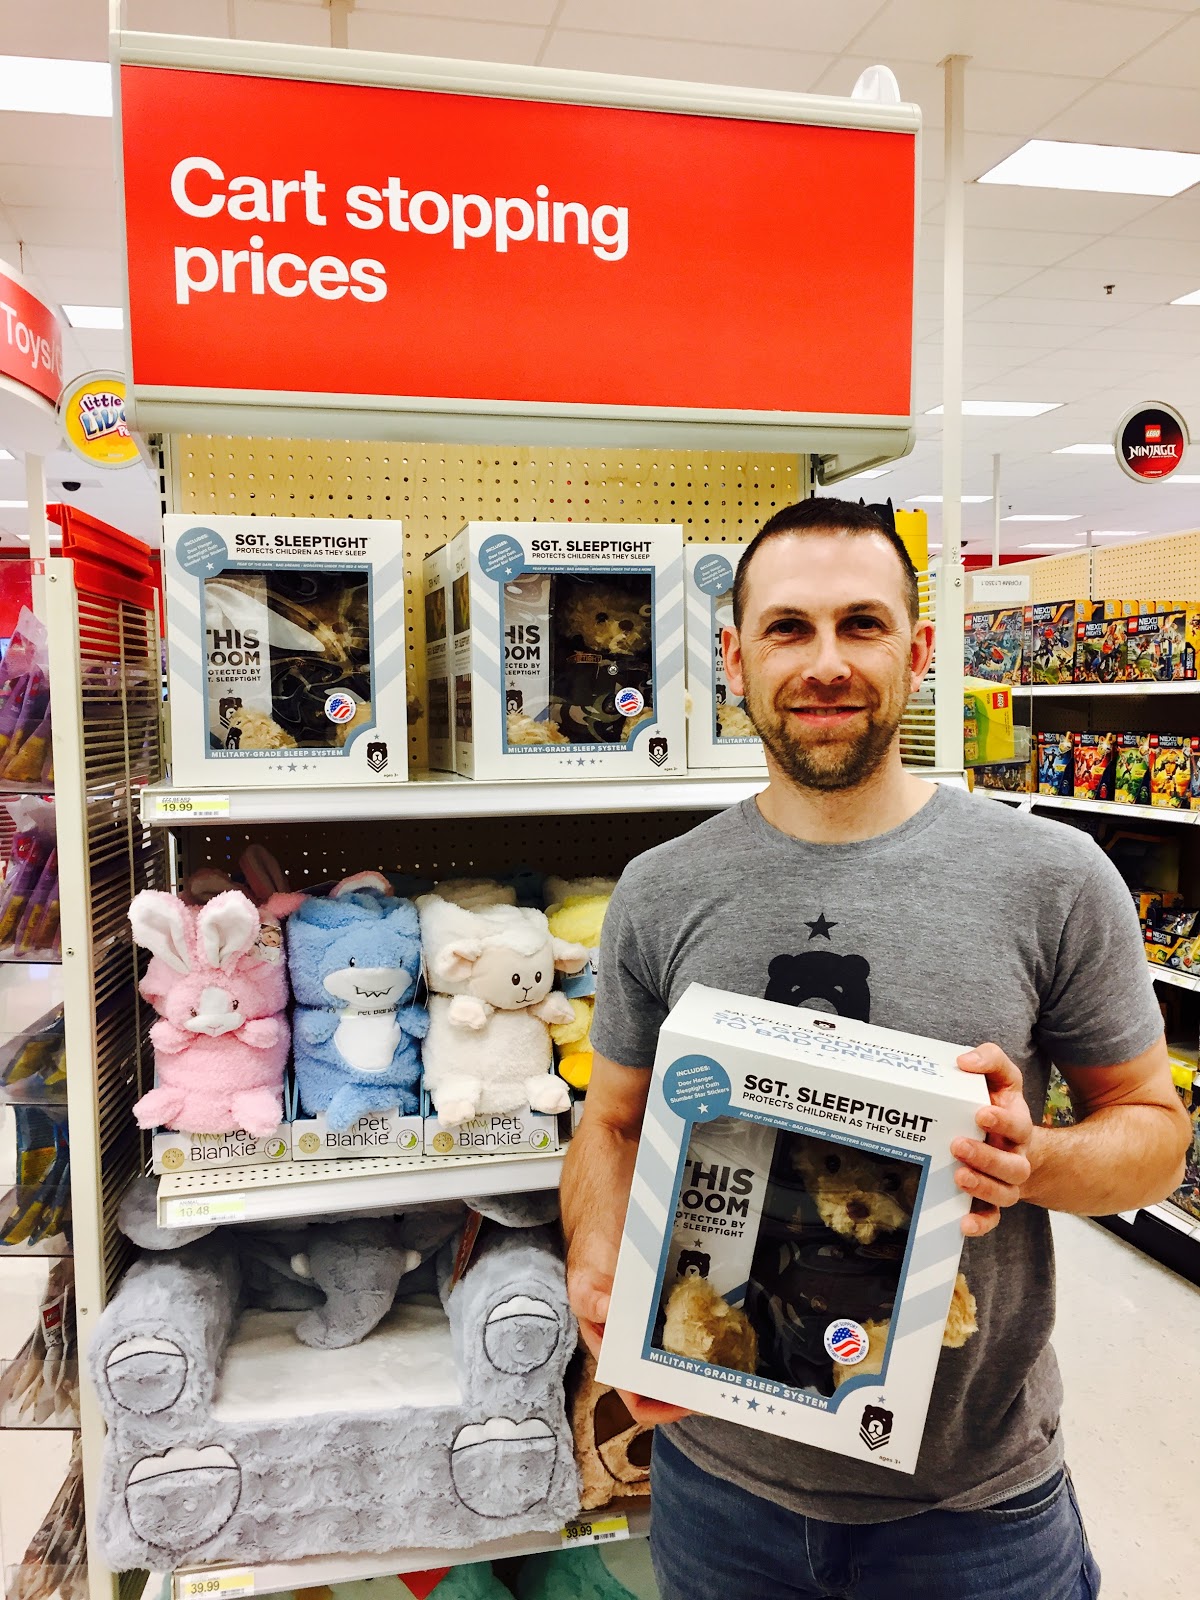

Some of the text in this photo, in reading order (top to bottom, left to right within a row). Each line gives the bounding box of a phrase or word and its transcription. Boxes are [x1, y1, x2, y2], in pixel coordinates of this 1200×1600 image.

[170, 156, 629, 261] Cart stopping
[174, 234, 388, 305] prices
[83, 394, 122, 411] Little
[1145, 429, 1161, 438] LEGO
[1128, 444, 1178, 460] NINJAGO
[235, 534, 269, 547] SGT.
[531, 540, 562, 551] SGT.
[1138, 617, 1158, 626] NEXO
[206, 629, 260, 649] HIS
[505, 625, 540, 644] HIS
[206, 651, 260, 666] OOM
[505, 646, 540, 660] OM
[211, 749, 344, 758] MILITARY-GRADE SLEEP SYSTEM
[508, 745, 571, 753] MILITARY-GRADE
[163, 803, 193, 811] 19.99
[712, 1012, 940, 1068] SAY GOODNIGHT
[713, 1017, 944, 1077] TO BAD DREAMS.
[676, 1065, 711, 1077] INCLUDES:
[692, 1075, 714, 1083] Hanger
[743, 1074, 790, 1099] SGT.
[670, 1095, 694, 1104] Slumber
[706, 1087, 730, 1096] Stickers
[676, 1081, 720, 1095] Sleeptight Oath
[358, 1117, 389, 1131] Pet
[491, 1116, 520, 1130] Pet
[742, 1091, 927, 1143] PROTECTS CHILDREN AS THEY SLEEP
[326, 1132, 389, 1147] Blankie
[459, 1131, 521, 1146] Blankie
[773, 1119, 788, 1127] DARK
[804, 1126, 826, 1136] DREAMS
[830, 1133, 860, 1145] MONSTERS
[860, 1141, 880, 1150] UNDER
[908, 1154, 925, 1162] MORE
[190, 1142, 257, 1161] Blankie
[685, 1160, 755, 1195] HIS
[678, 1189, 750, 1218] OOM
[180, 1206, 209, 1217] 10.48
[675, 1211, 745, 1229] OTECTED BY
[683, 1222, 744, 1238] SLEEPTIGHT
[649, 1352, 828, 1410] MILITARY-GRADE SLEEP SYSTEM
[566, 1525, 593, 1539] 39.99
[190, 1580, 220, 1594] 39.99
